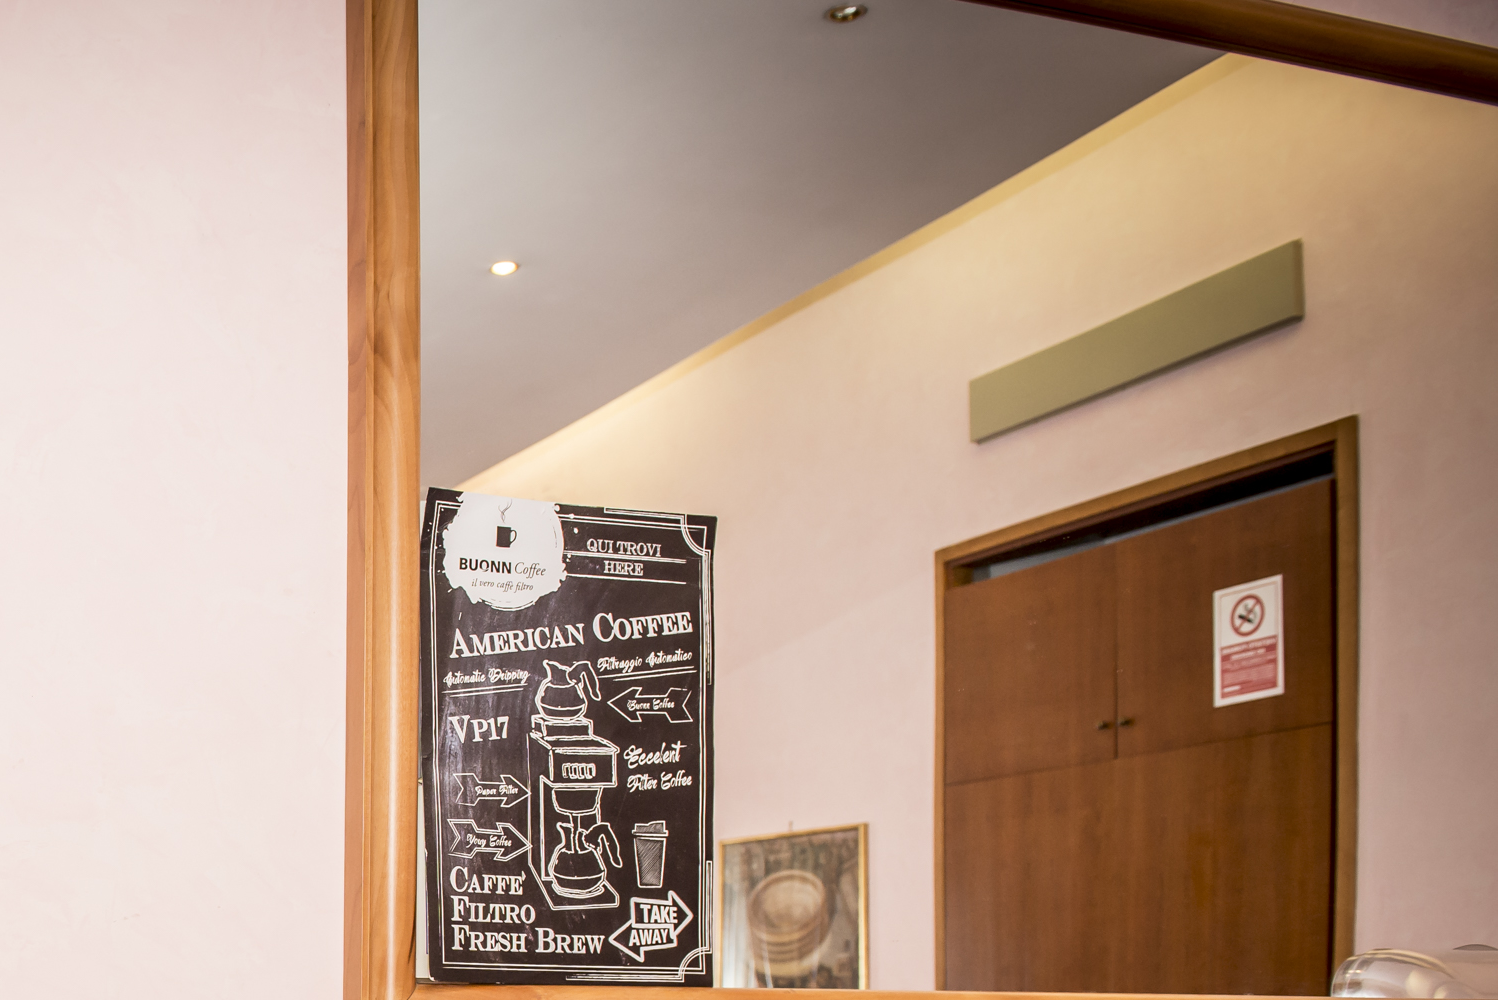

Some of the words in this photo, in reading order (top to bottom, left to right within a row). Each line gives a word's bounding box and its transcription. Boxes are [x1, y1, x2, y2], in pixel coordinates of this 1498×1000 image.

[586, 538, 613, 554] QUI
[616, 541, 662, 558] TROVI
[459, 557, 512, 574] BUONN
[514, 562, 546, 579] Coffee
[604, 560, 644, 577] HERE
[471, 578, 478, 587] il
[514, 582, 533, 593] filtro
[449, 622, 586, 659] AMERICAN
[592, 610, 694, 643] COFFEE
[597, 656, 643, 673] Filtraggio
[645, 648, 693, 668] Automatico
[443, 669, 486, 688] Automatic
[488, 668, 530, 684] Dripping
[652, 698, 675, 710] Coffee
[448, 715, 510, 743] VP17
[623, 740, 687, 769] Eccelent
[626, 773, 658, 792] Filter
[661, 769, 693, 790] Coffee
[474, 786, 497, 797] Paper
[489, 835, 512, 847] Coffee
[450, 895, 536, 924] FILTRO
[639, 903, 678, 924] TAKE
[451, 924, 527, 952] FRESH
[535, 927, 606, 955] BREW
[629, 927, 669, 947] AWAY
